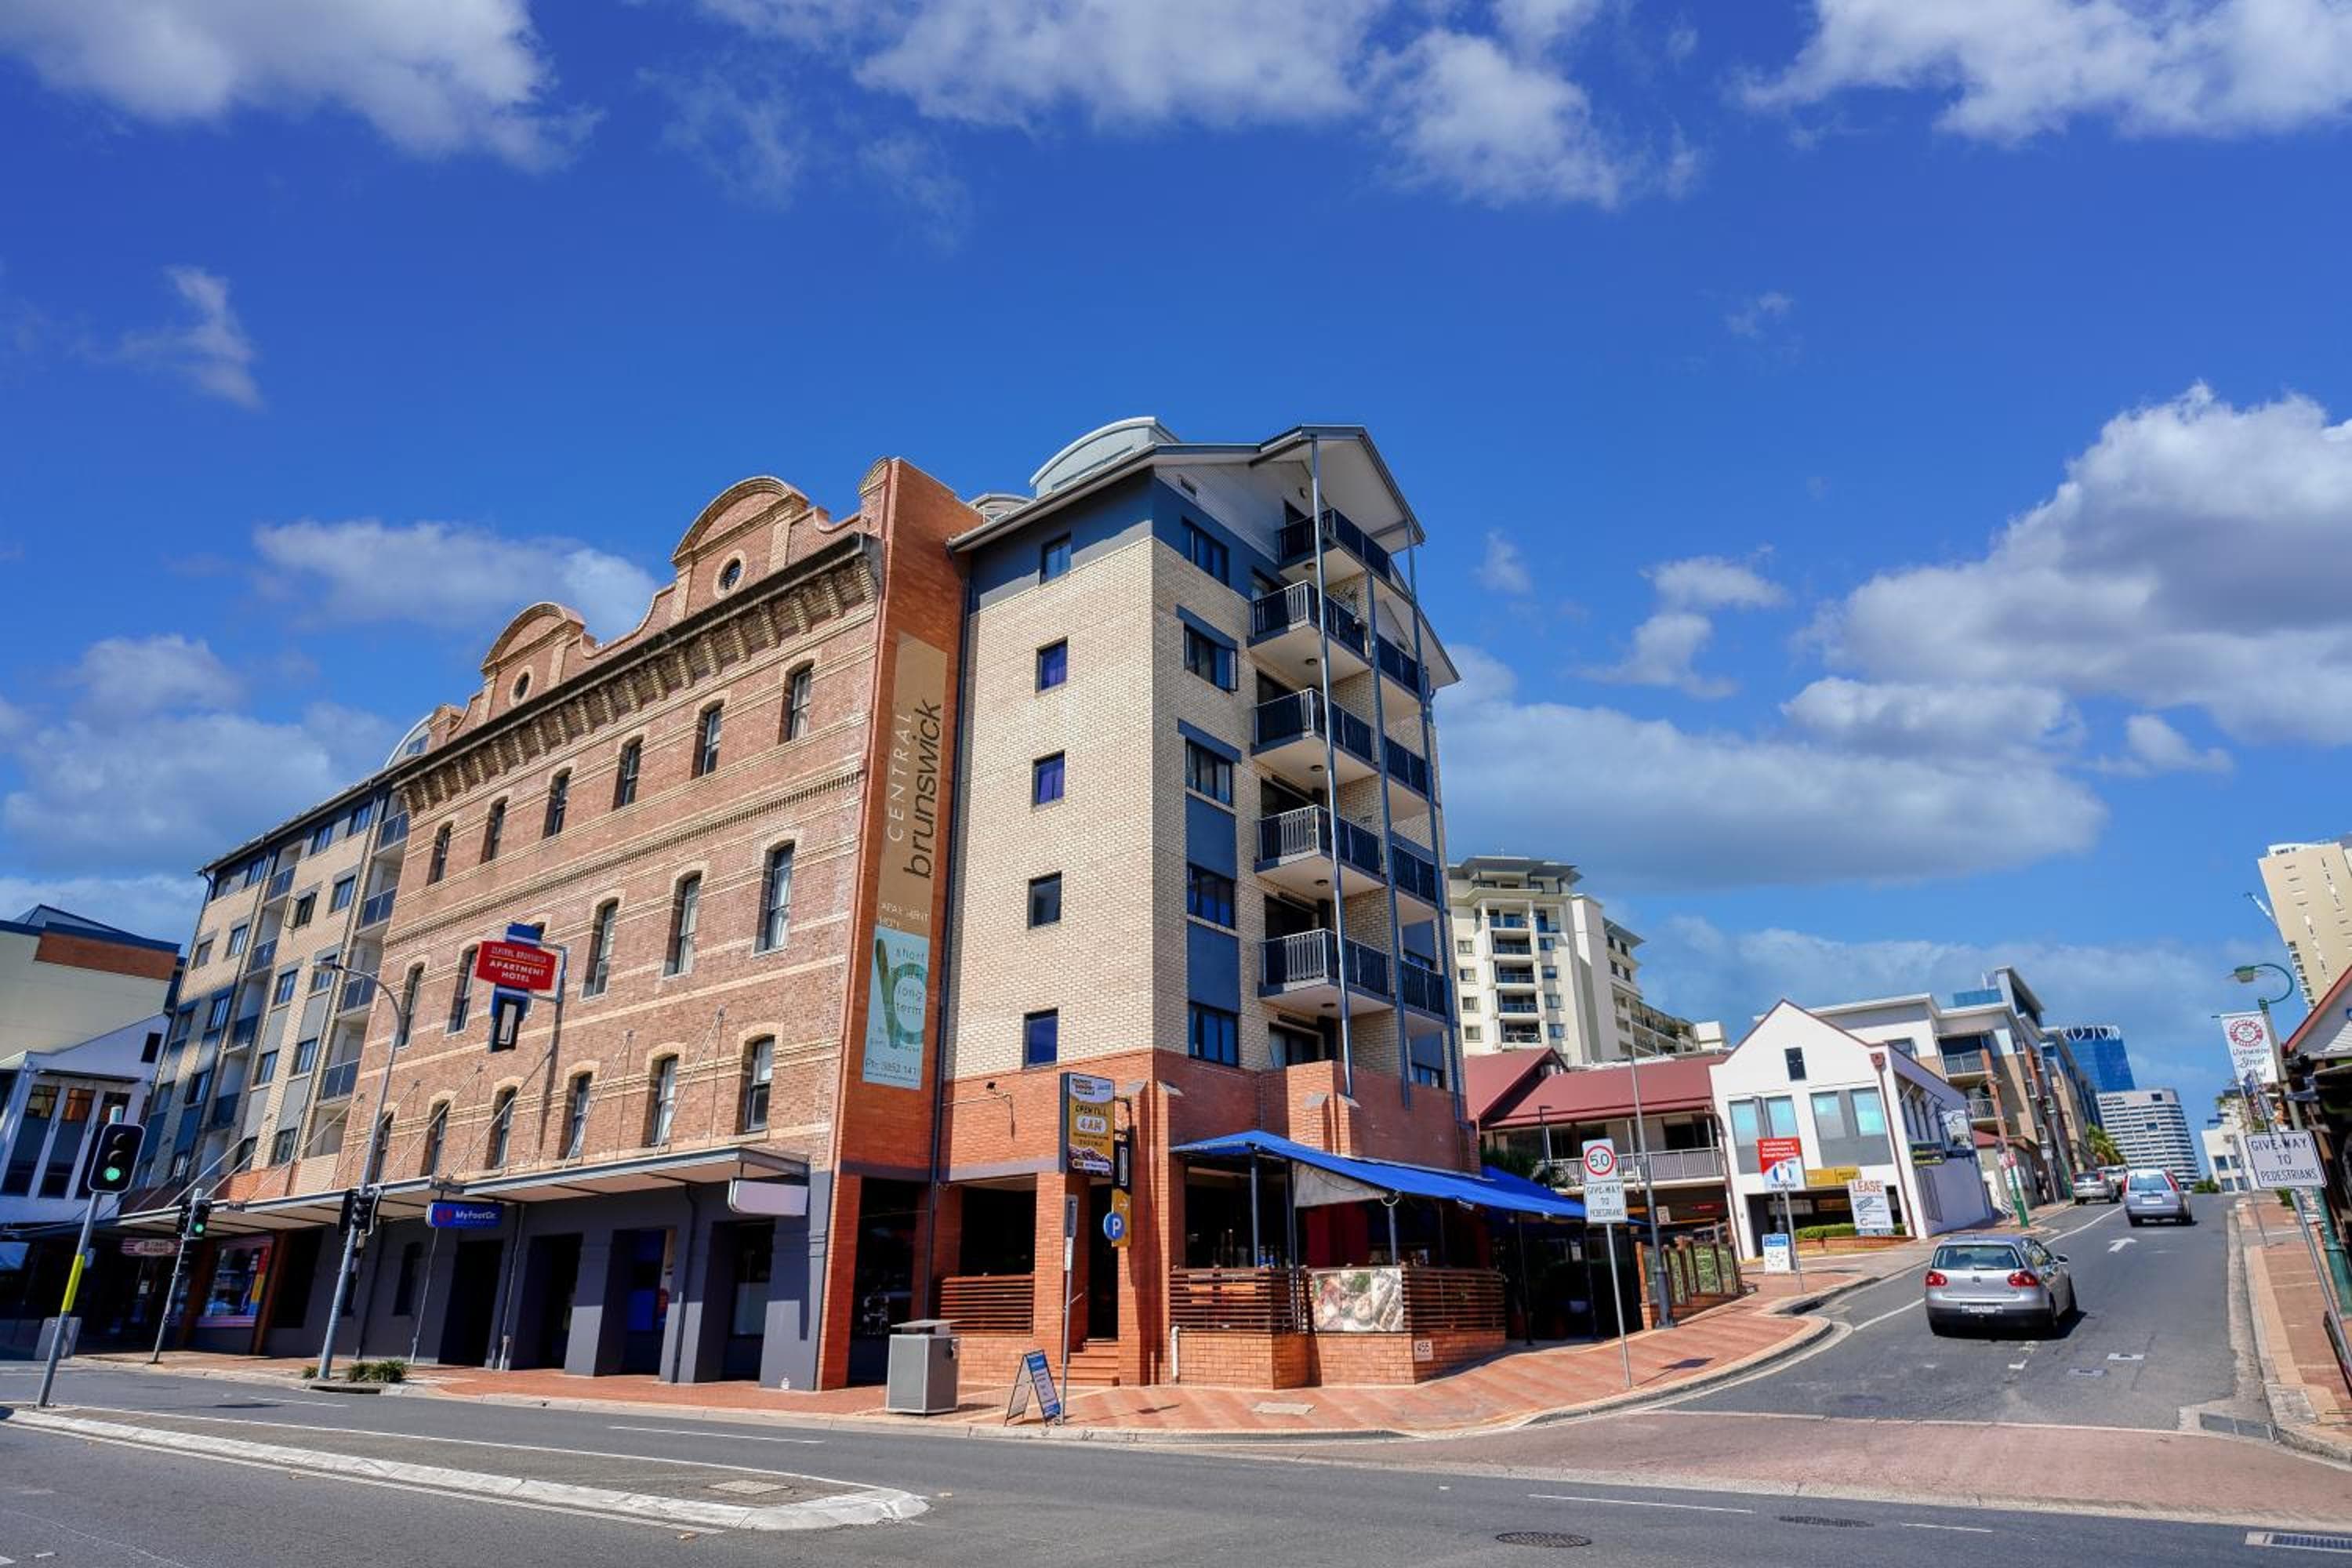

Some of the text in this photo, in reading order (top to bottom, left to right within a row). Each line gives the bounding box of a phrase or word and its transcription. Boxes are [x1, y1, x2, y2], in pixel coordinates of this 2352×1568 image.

[887, 713, 913, 842] CENTRAL
[903, 699, 942, 879] brunswick
[896, 946, 925, 960] short
[488, 960, 545, 976] APARTMENT
[501, 971, 530, 982] HOTEL
[897, 985, 924, 1003] long
[896, 1003, 923, 1015] term
[2237, 1056, 2265, 1068] Street
[2251, 1138, 2307, 1151] GIVE WAY
[2277, 1153, 2292, 1166] TO
[2260, 1168, 2318, 1181] PEDESTRIANS
[1853, 1179, 1884, 1192] LEASE
[1112, 1218, 1122, 1236] P
